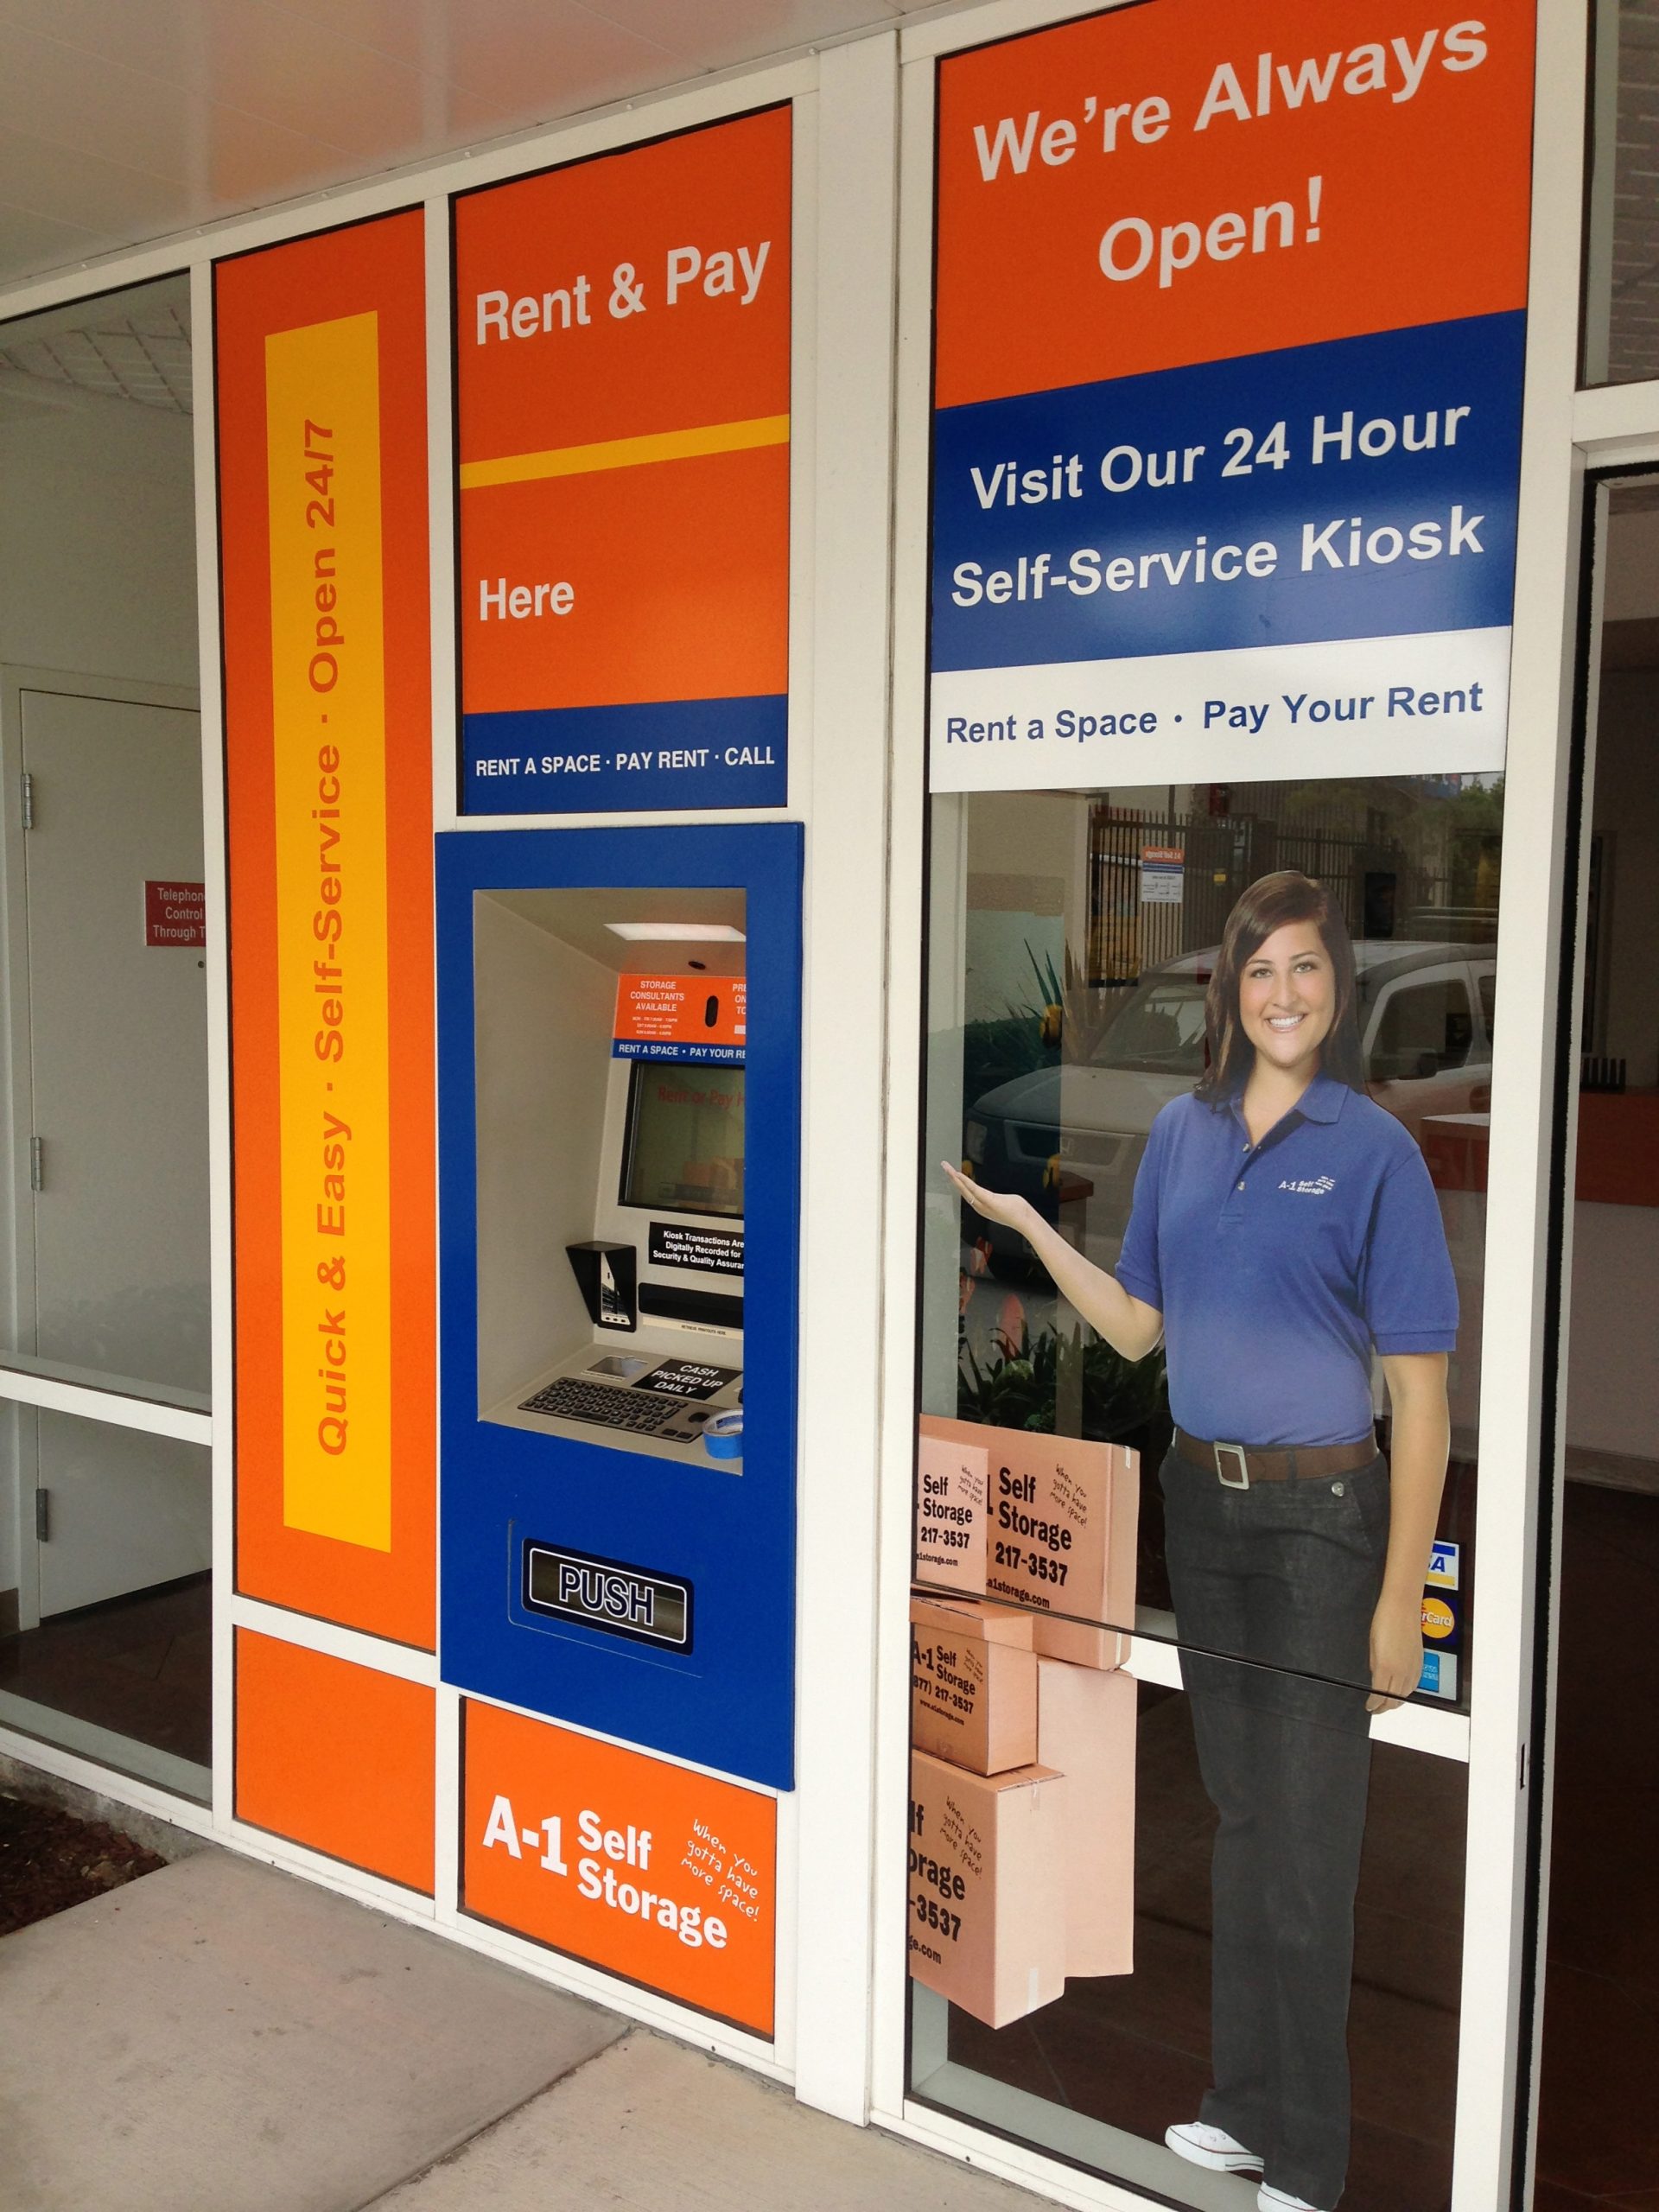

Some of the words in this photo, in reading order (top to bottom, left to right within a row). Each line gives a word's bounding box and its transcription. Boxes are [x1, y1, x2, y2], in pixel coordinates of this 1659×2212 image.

[973, 92, 1171, 182] We're
[1192, 19, 1489, 132] Always
[1098, 175, 1323, 289] Open!
[477, 275, 591, 346] Rent
[608, 262, 646, 319] &
[667, 241, 771, 305] Pay
[304, 419, 335, 529] 24/7
[970, 454, 1084, 510] Visit
[1100, 442, 1205, 493] Our
[1221, 421, 1290, 478] 24
[1311, 405, 1471, 466] Hour
[951, 536, 1278, 607] Self-Service
[1300, 505, 1485, 573] Kiosk
[480, 577, 575, 621] Here
[308, 548, 345, 693] Open
[946, 714, 1017, 745] Rent
[1027, 719, 1046, 741] a
[1055, 708, 1158, 747] Space
[1203, 700, 1269, 735] Pay
[1281, 690, 1375, 725] Your
[1387, 681, 1484, 719] Rent
[476, 759, 520, 777] RENT
[524, 758, 537, 775] A
[541, 754, 601, 774] SPACE
[616, 752, 653, 771] PAY
[658, 749, 709, 769] RENT
[724, 746, 775, 766] CALL
[157, 887, 206, 904] Telephon
[312, 744, 344, 1063] Self-Service
[165, 906, 203, 920] Control
[153, 925, 196, 941] Through
[630, 991, 684, 1001] CONSULTANTS
[640, 981, 677, 989] STORAGE
[635, 1002, 677, 1012] AVAILABLE
[619, 1044, 641, 1054] RENT
[650, 1046, 678, 1056] SPACE
[690, 1047, 708, 1057] PAY
[709, 1048, 734, 1058] YOUR
[316, 1110, 352, 1236] Easy
[663, 1230, 683, 1240] Kiosk
[684, 1233, 730, 1247] Transactions
[731, 1239, 745, 1249] Are
[665, 1241, 694, 1254] Digitally
[695, 1245, 729, 1256] Recorded
[316, 1255, 346, 1292] &
[653, 1250, 682, 1262] Security
[690, 1255, 715, 1267] Quality
[317, 1308, 349, 1456] Quick
[651, 1370, 702, 1384] PICKED
[702, 1379, 724, 1388] UP
[679, 1365, 719, 1376] CASH
[653, 1382, 697, 1394] DAILY
[923, 1474, 949, 1497] Self
[999, 1466, 1036, 1503] Self
[923, 1497, 973, 1526] Storage
[998, 1501, 1071, 1552] Storage
[921, 1526, 970, 1549] 217-3537
[995, 1541, 1068, 1586] 217-3537
[559, 1563, 654, 1627] PUSH
[912, 1641, 935, 1671] A-1
[937, 1645, 957, 1668] Self
[936, 1663, 976, 1695] Storage
[934, 1685, 974, 1714] 217-3537
[946, 1796, 965, 1825] When
[482, 1794, 567, 1877] A-1
[577, 1809, 652, 1871] Self
[693, 1819, 727, 1854] When
[940, 1827, 957, 1850] more
[965, 1834, 982, 1861] have
[687, 1840, 722, 1872] gotta
[727, 1866, 758, 1899] have
[577, 1858, 728, 1949] Storage
[681, 1858, 714, 1885] more
[718, 1885, 760, 1922] space!
